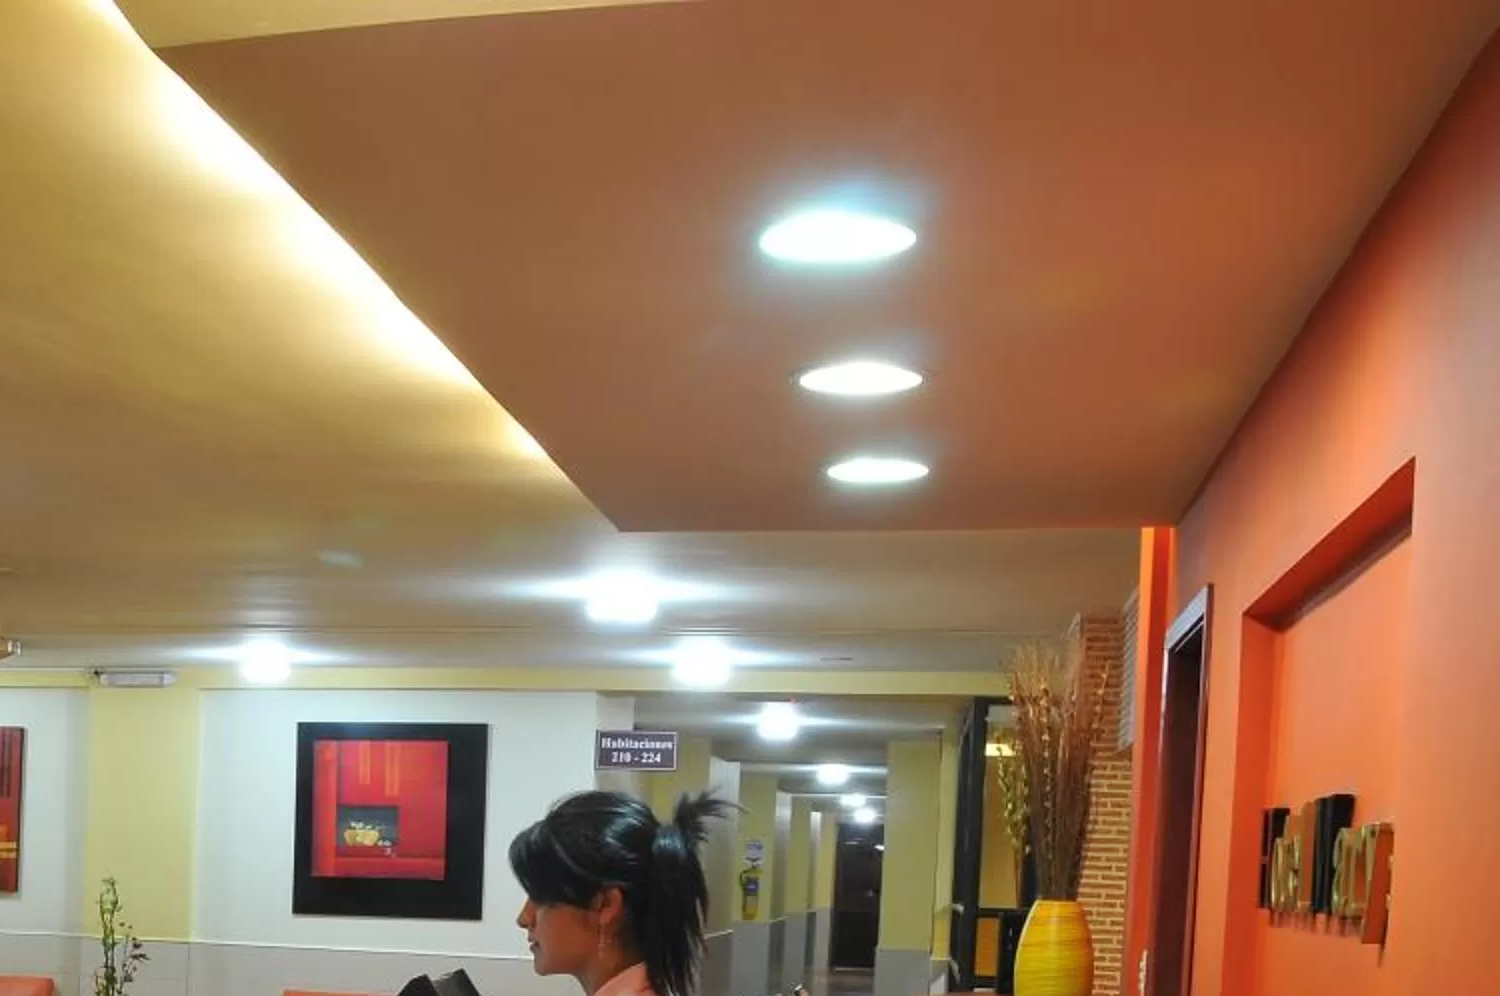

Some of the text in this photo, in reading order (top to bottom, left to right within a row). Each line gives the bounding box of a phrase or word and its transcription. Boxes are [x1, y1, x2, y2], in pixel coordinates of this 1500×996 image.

[601, 737, 673, 750] Habitaciones
[611, 751, 632, 763] 210
[641, 751, 661, 763] 224
